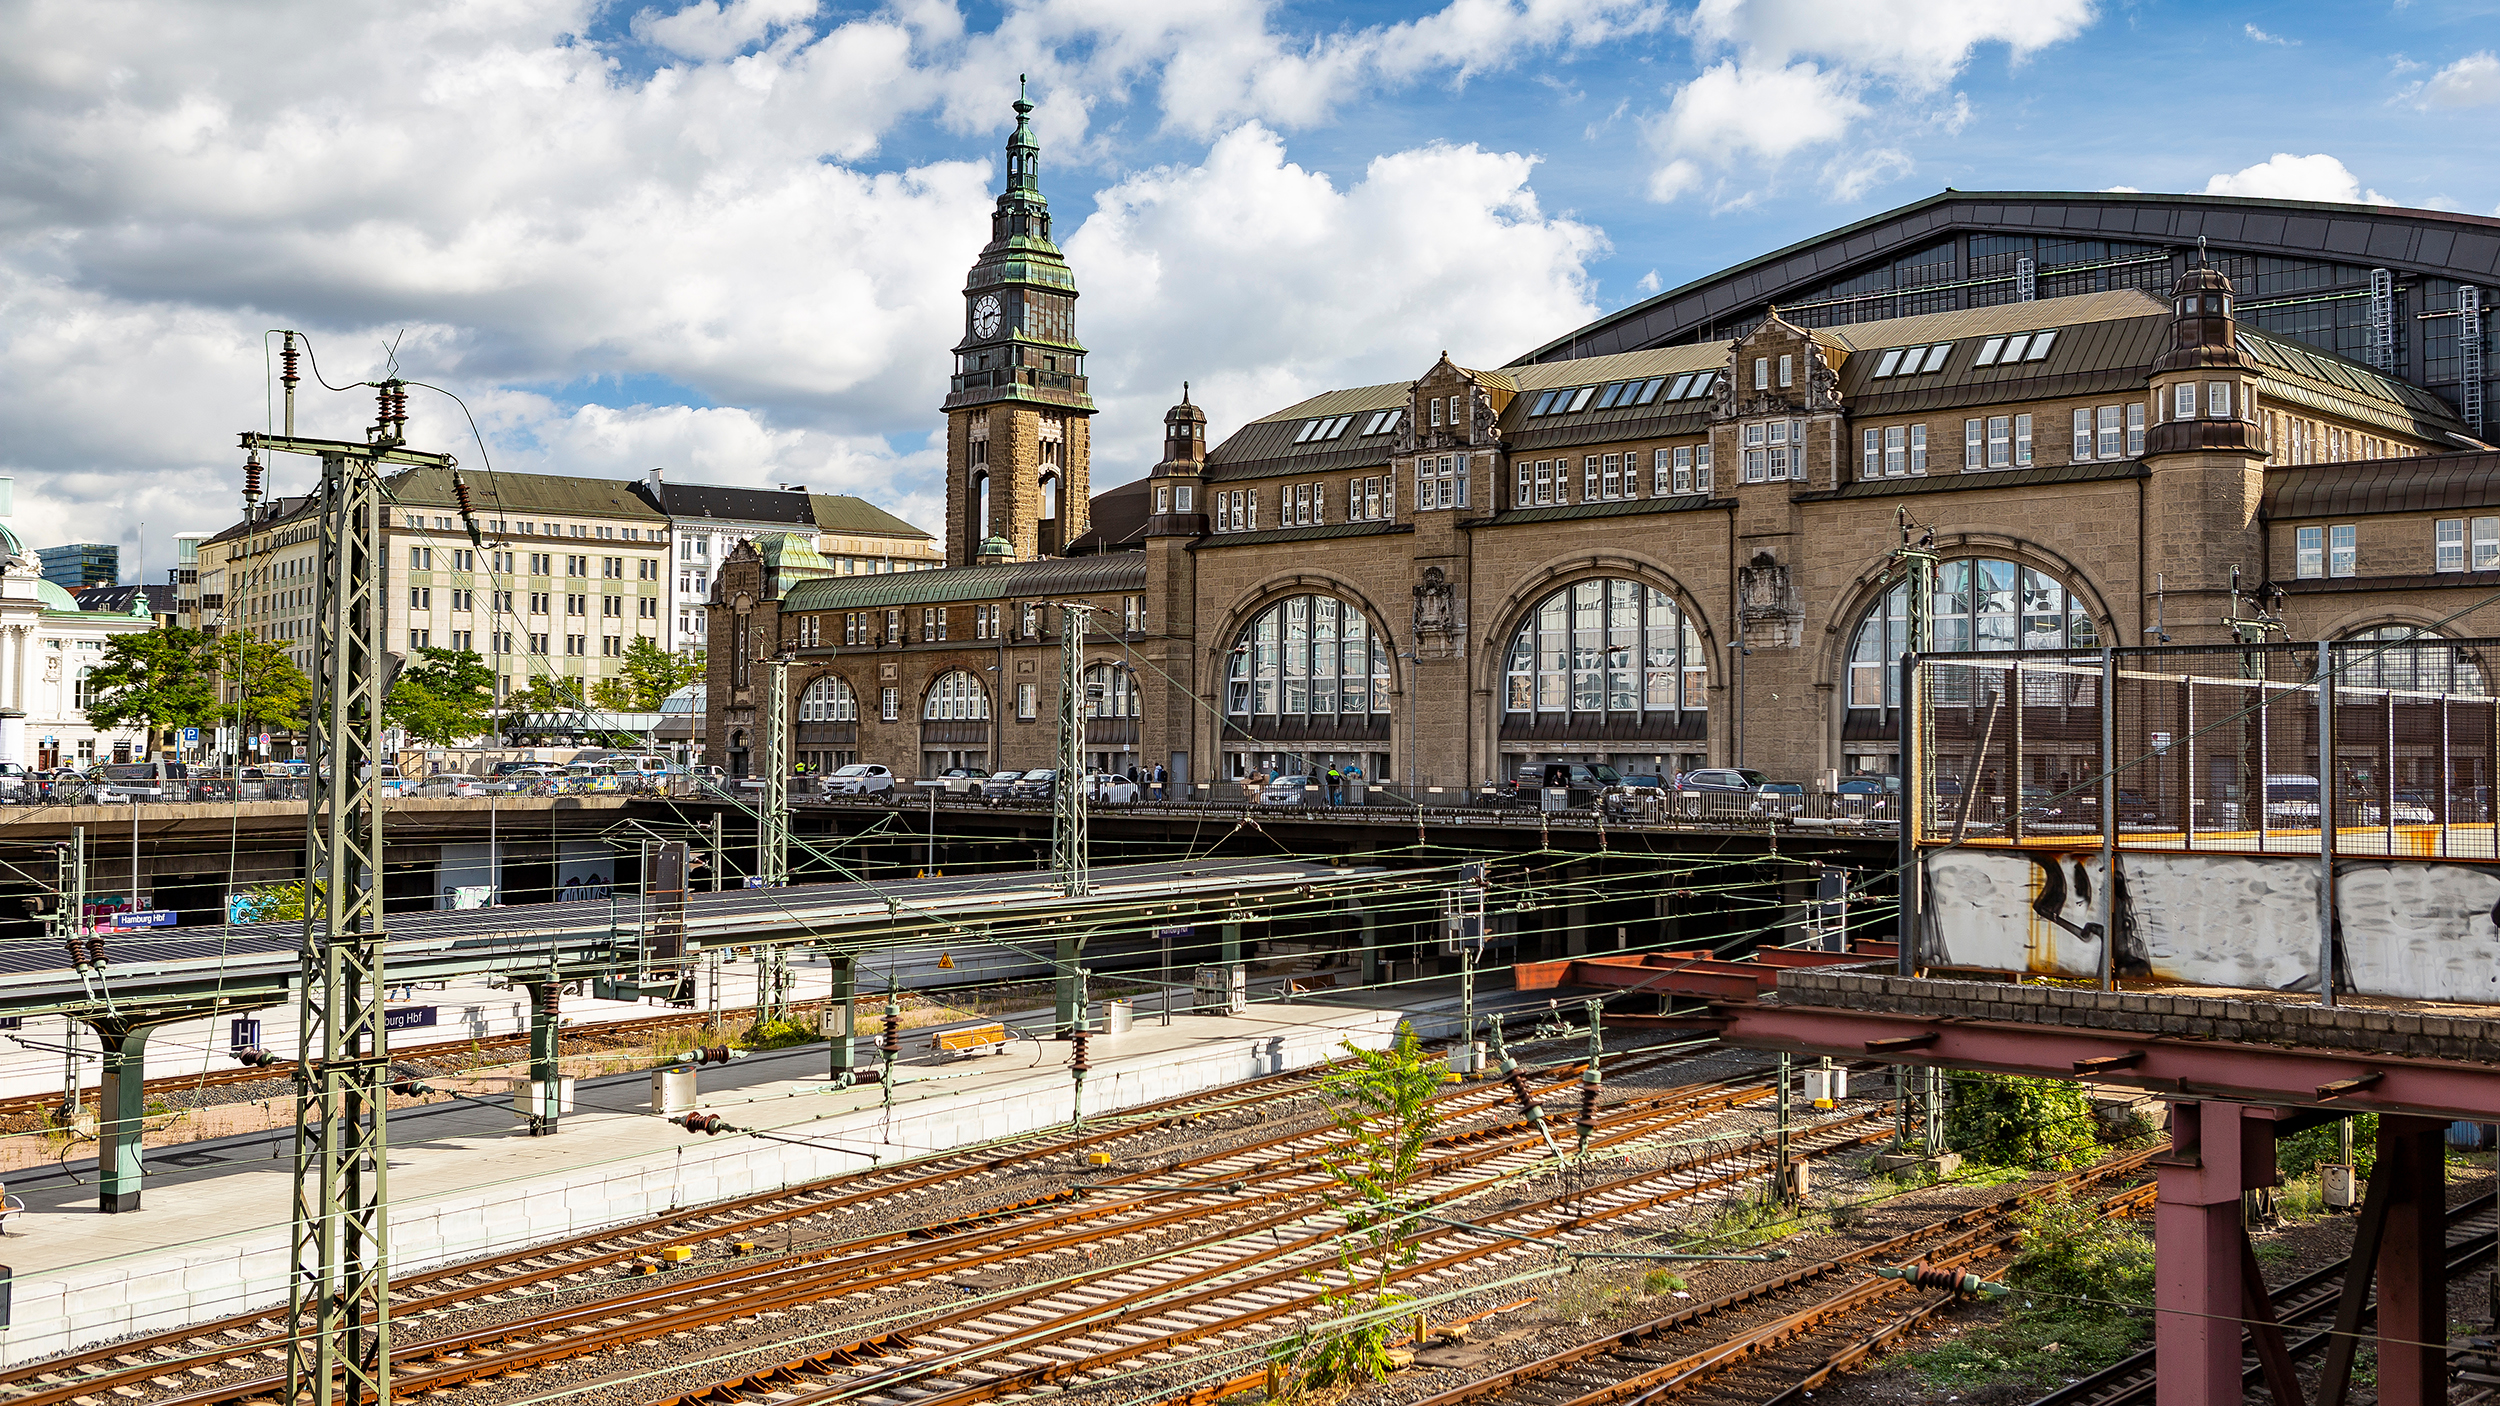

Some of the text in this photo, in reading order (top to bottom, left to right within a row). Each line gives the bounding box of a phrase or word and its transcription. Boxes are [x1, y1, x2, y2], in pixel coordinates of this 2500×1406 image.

[187, 729, 196, 740] P
[121, 913, 166, 925] Hamburg Hbf
[406, 1011, 423, 1024] Hbf
[826, 1012, 832, 1028] F
[238, 1022, 251, 1046] H
